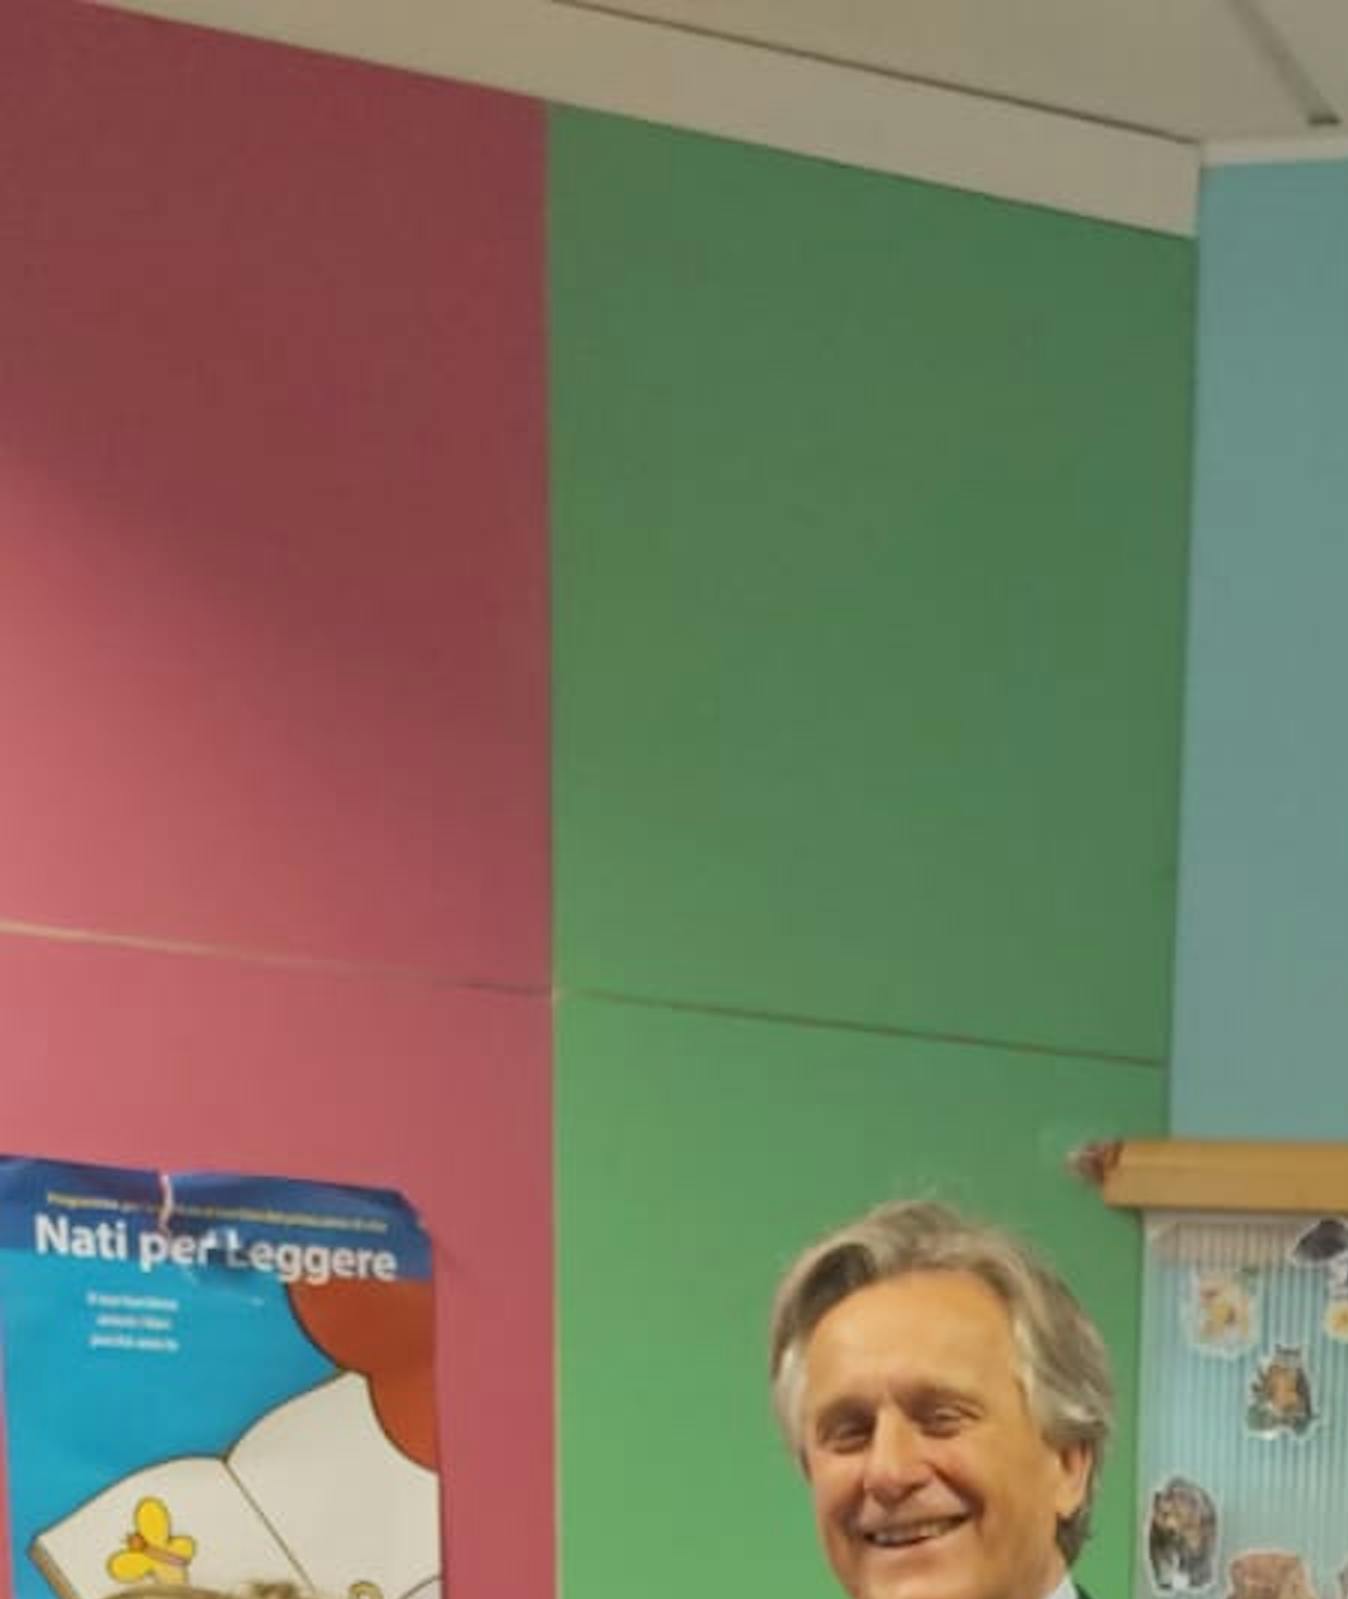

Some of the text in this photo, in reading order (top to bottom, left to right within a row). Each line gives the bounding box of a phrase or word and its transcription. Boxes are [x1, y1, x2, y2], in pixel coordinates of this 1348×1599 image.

[34, 1213, 128, 1261] Nati
[139, 1227, 217, 1273] per
[225, 1228, 397, 1286] Leggere
